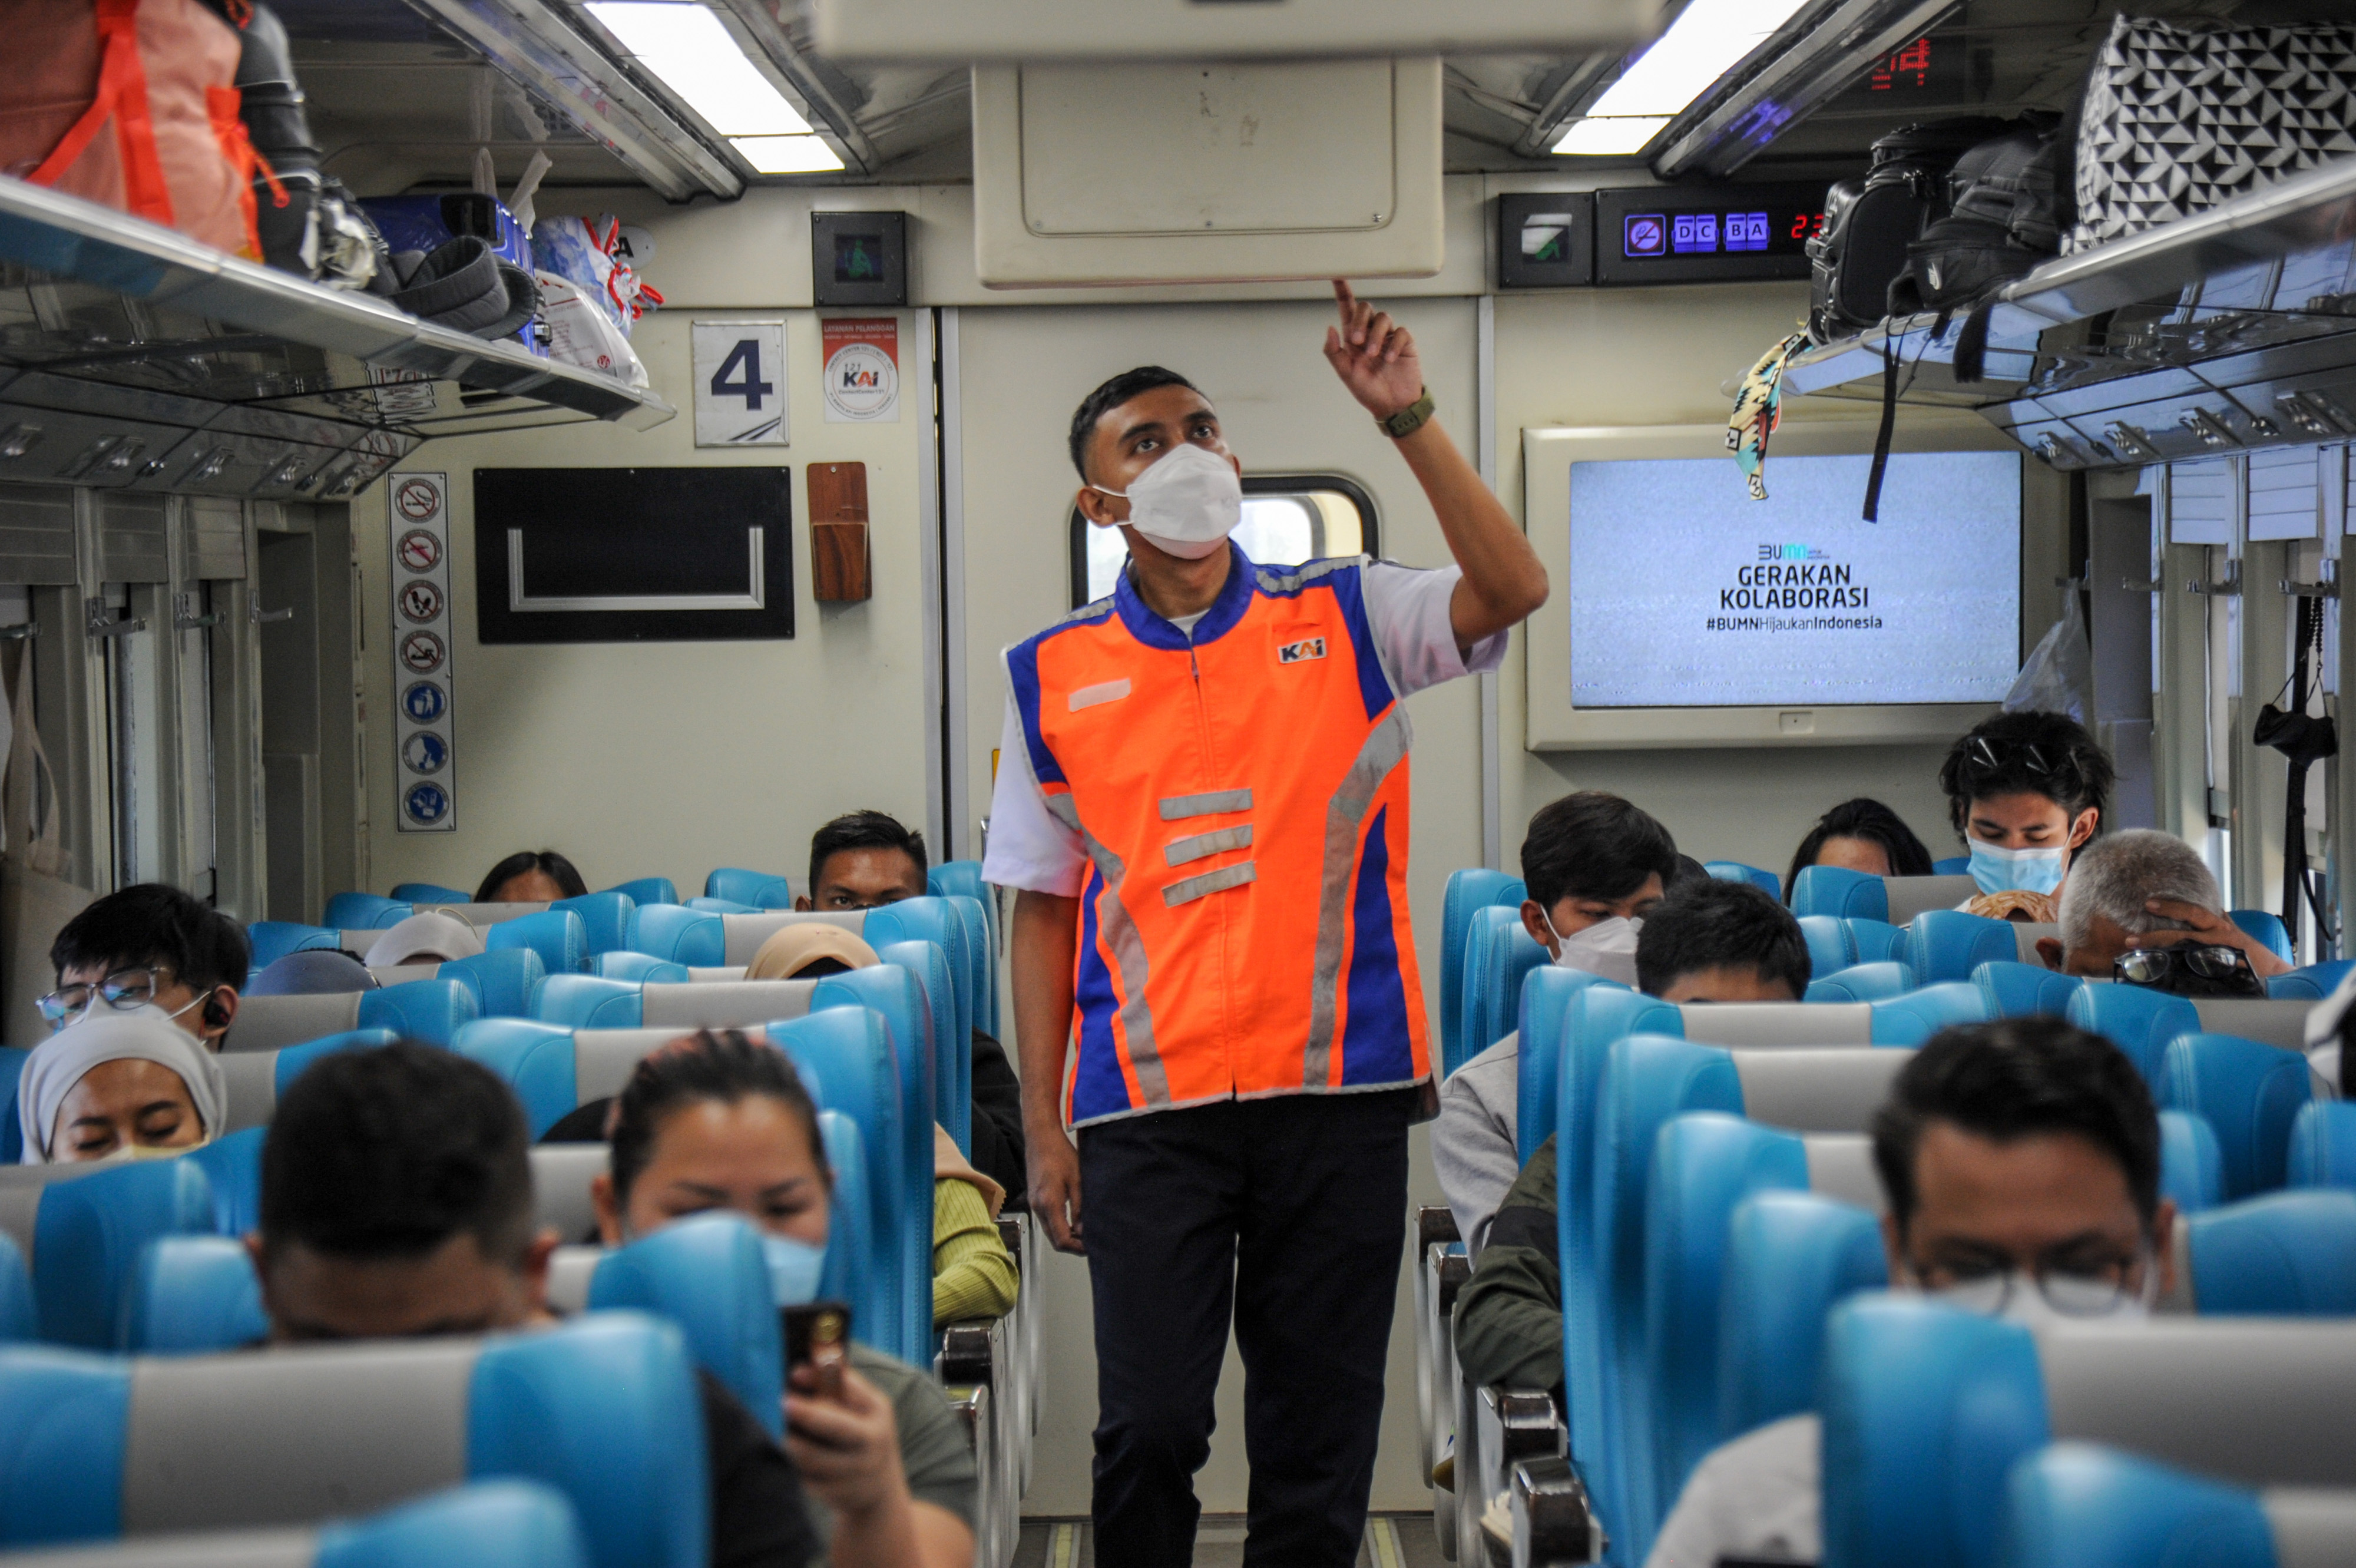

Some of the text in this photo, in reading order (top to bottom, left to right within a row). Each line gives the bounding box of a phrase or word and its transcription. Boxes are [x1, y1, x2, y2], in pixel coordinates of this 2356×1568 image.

[1680, 223, 1762, 238] D C B A
[711, 339, 773, 411] 4
[845, 363, 861, 372] 121
[843, 371, 878, 387] KAI
[1738, 564, 1850, 586] GERAKAN
[1720, 587, 1868, 609] KOLABORASI
[1706, 616, 1882, 633] #BUMNHijaukanIndonesia
[1282, 639, 1323, 661] KAI
